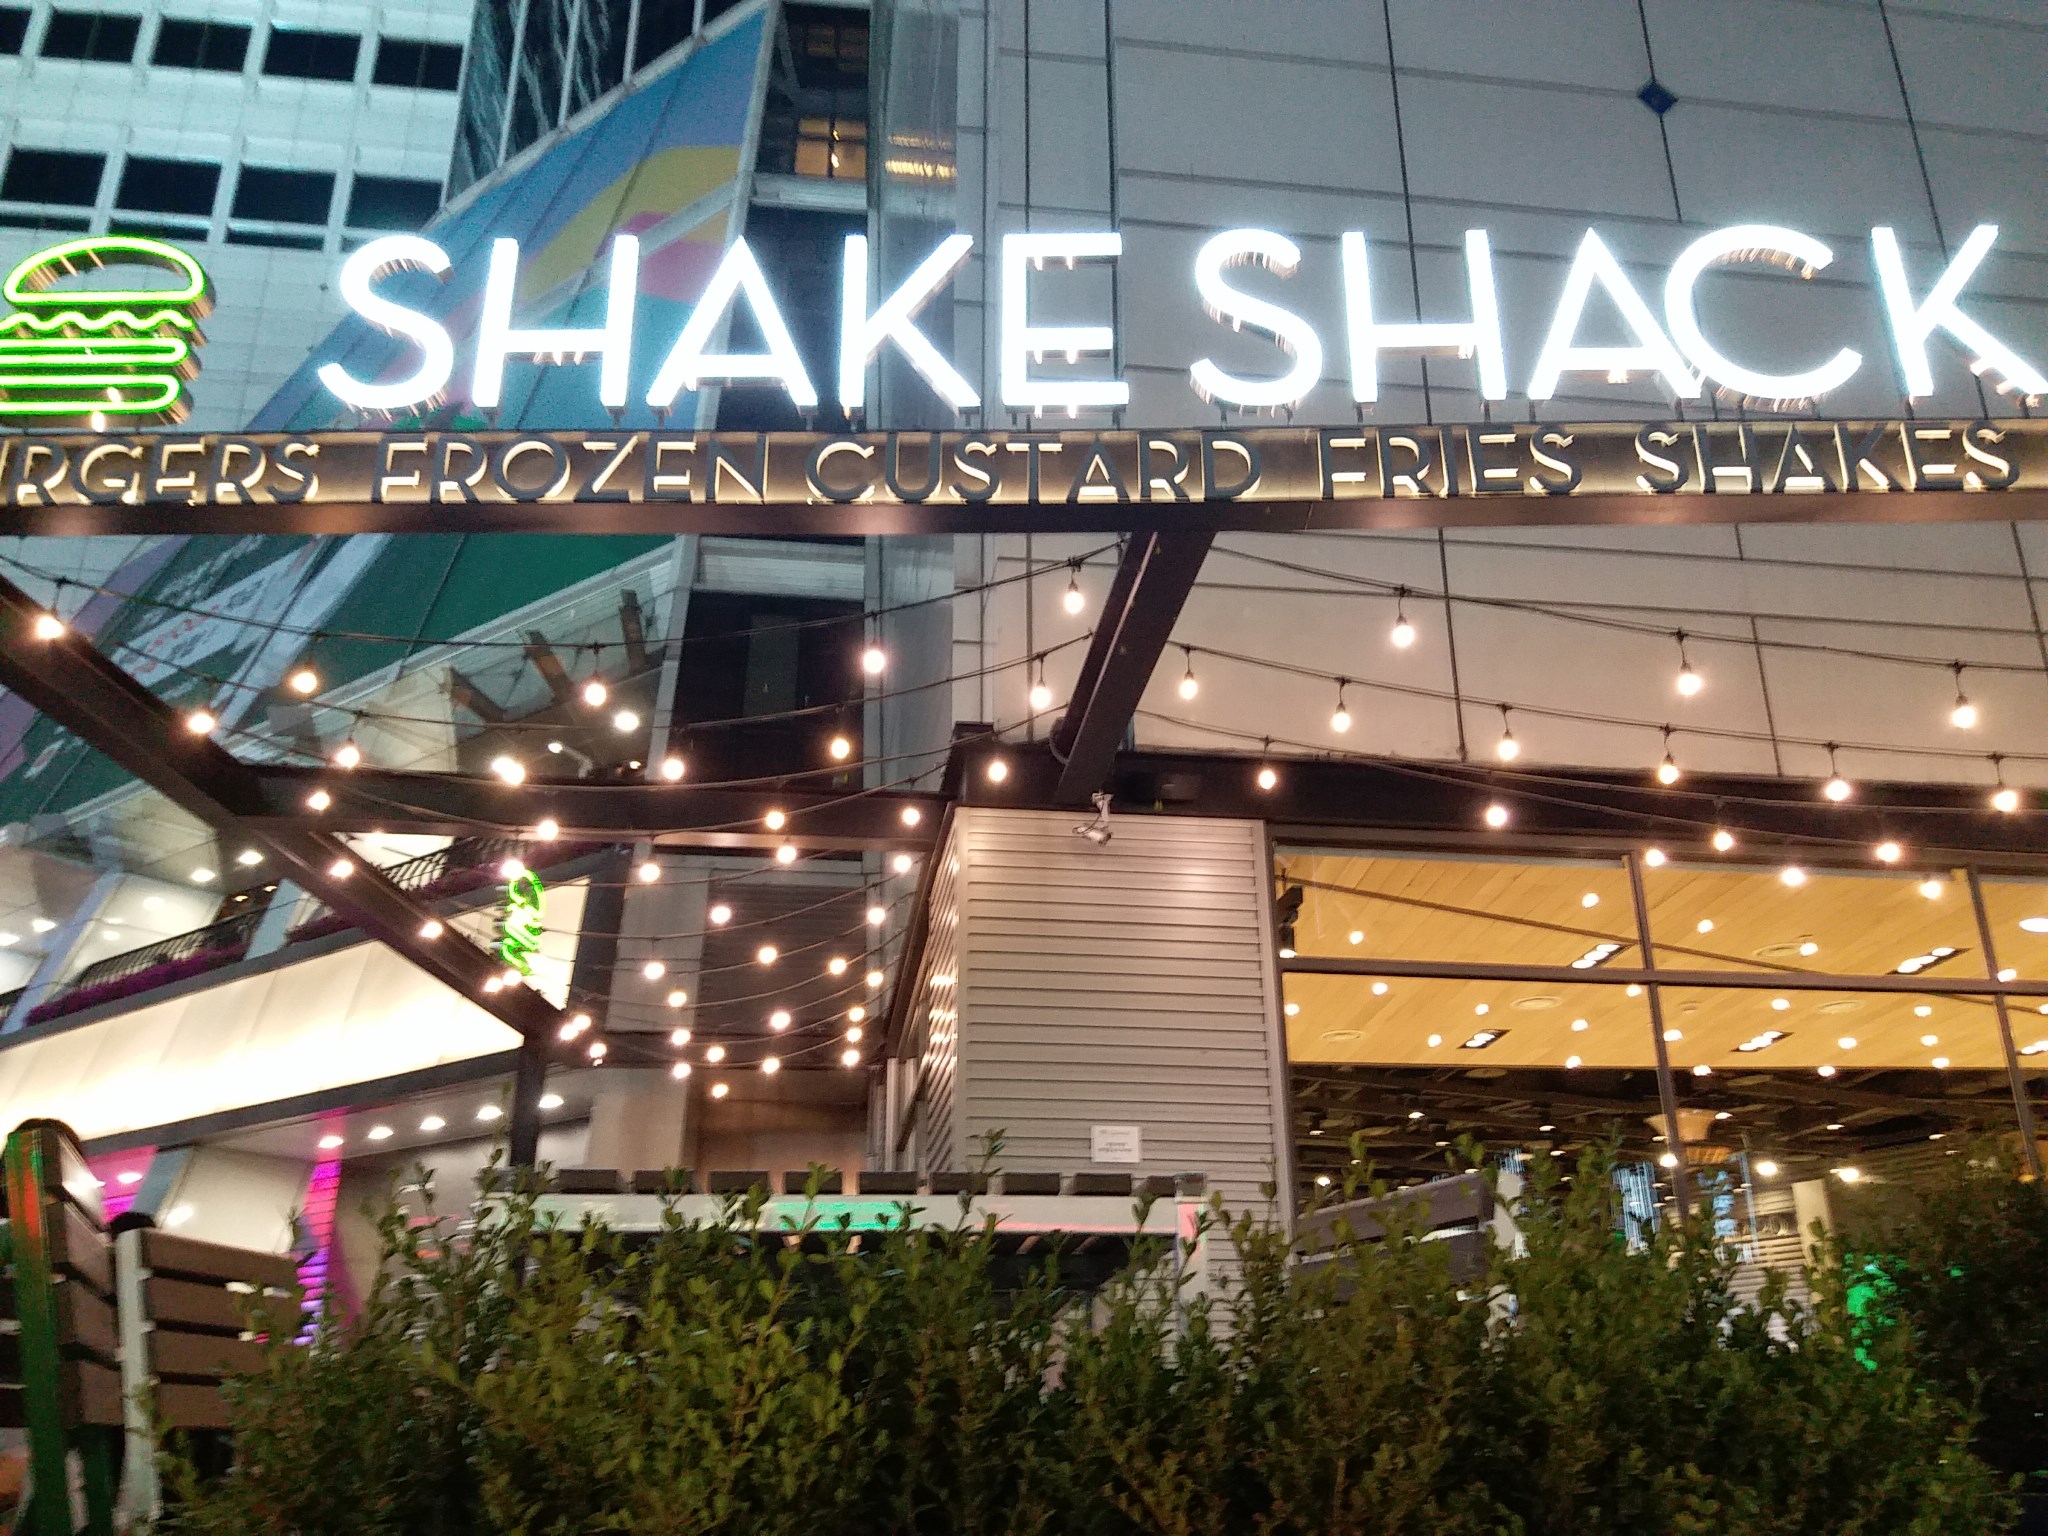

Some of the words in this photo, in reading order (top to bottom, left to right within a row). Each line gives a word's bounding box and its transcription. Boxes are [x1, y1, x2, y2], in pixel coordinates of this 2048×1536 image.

[316, 231, 1130, 410] SHAKE
[1189, 224, 2048, 408] SHACK
[0, 436, 319, 505] RGERS
[371, 432, 769, 504] FROZEN
[804, 431, 1262, 504] CUSTARD
[1316, 425, 1583, 499] FRIES
[1634, 421, 2020, 494] SHAKES
